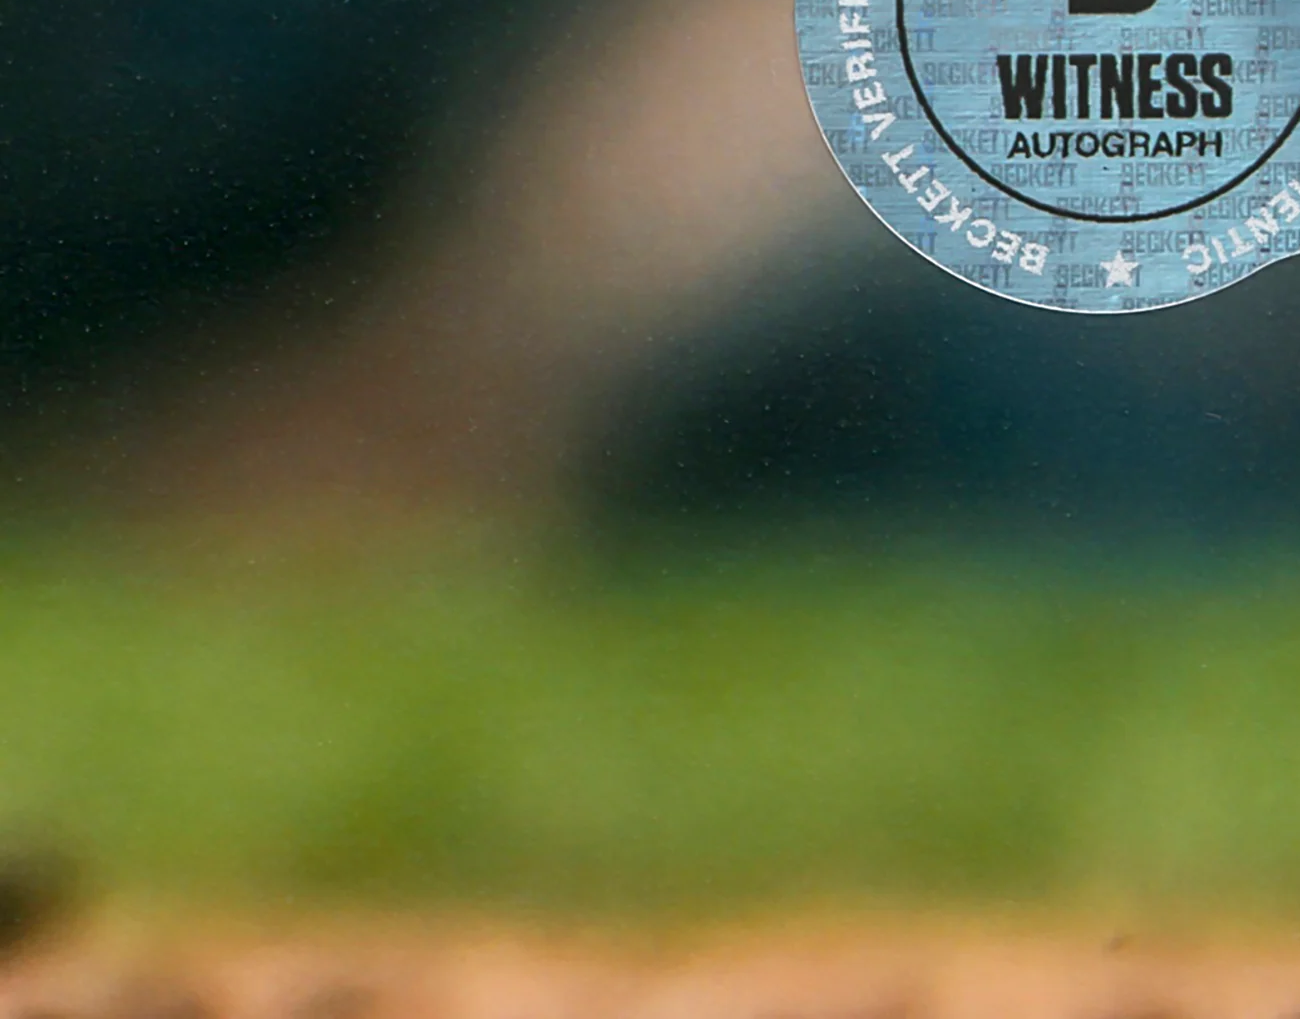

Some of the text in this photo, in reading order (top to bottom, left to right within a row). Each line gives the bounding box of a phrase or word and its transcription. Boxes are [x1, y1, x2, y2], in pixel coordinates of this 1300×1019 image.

[997, 52, 1234, 120] WITNESS
[1007, 131, 1223, 159] AUTOGRAPH
[882, 144, 1050, 276] BECKETT
